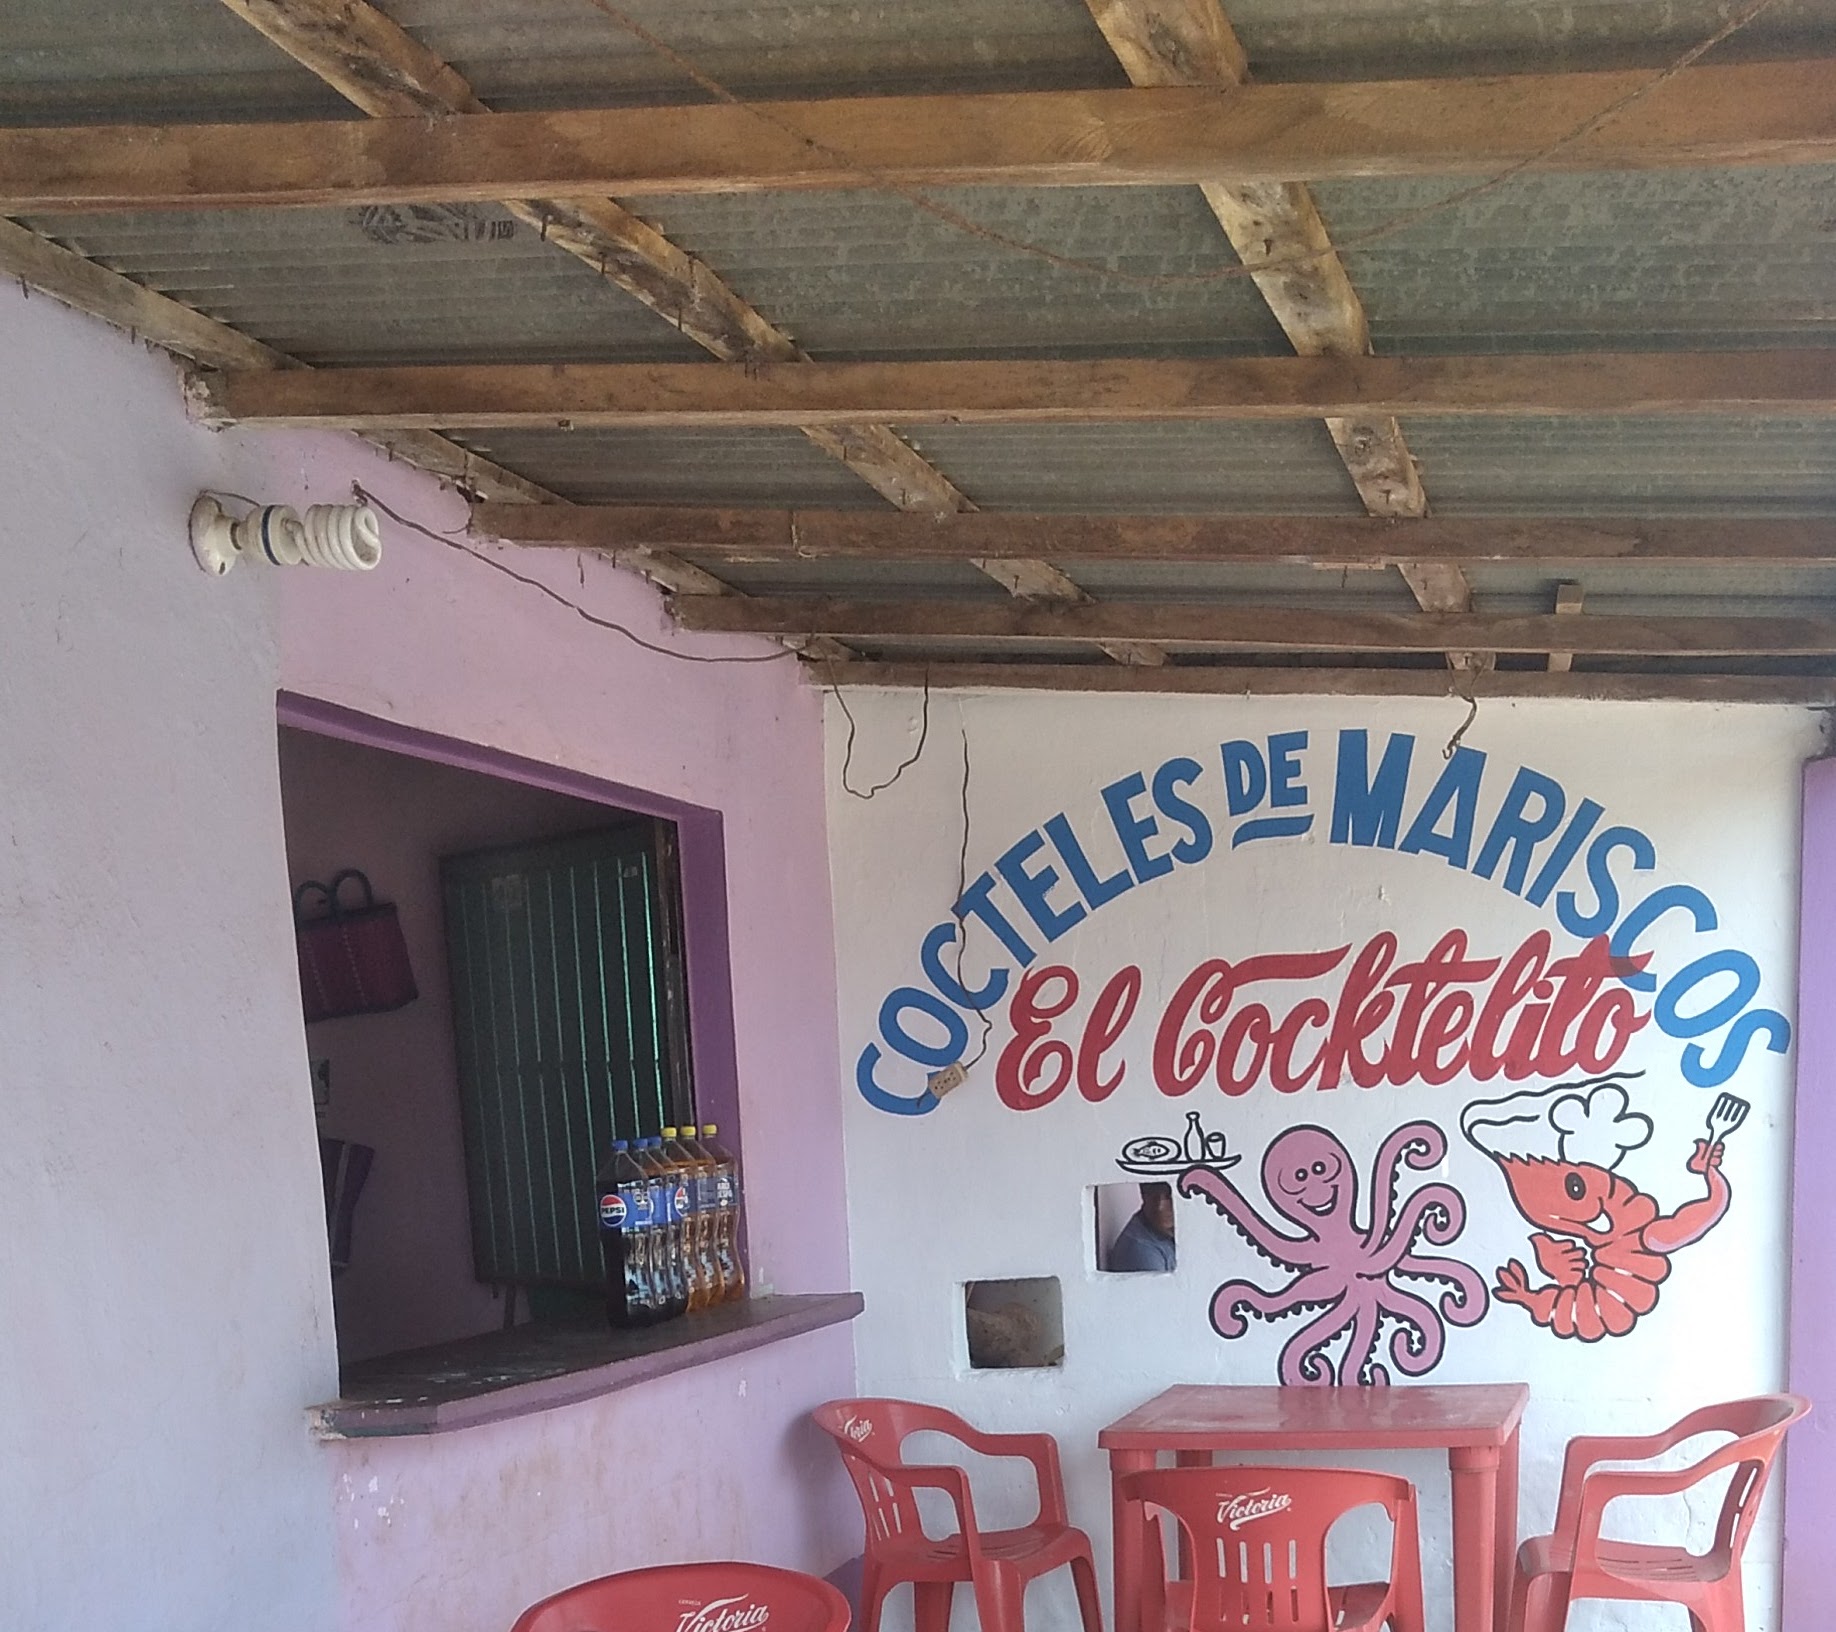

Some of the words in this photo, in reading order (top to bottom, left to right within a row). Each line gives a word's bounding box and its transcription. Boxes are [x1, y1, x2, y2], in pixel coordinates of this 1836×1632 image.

[857, 758, 1212, 1116] COCTELES
[1222, 732, 1308, 816] DE
[1331, 730, 1791, 1088] MARISCOS
[995, 965, 1142, 1112] El
[1153, 929, 1652, 1098] Cocktelito
[1216, 1486, 1292, 1531] Victoria
